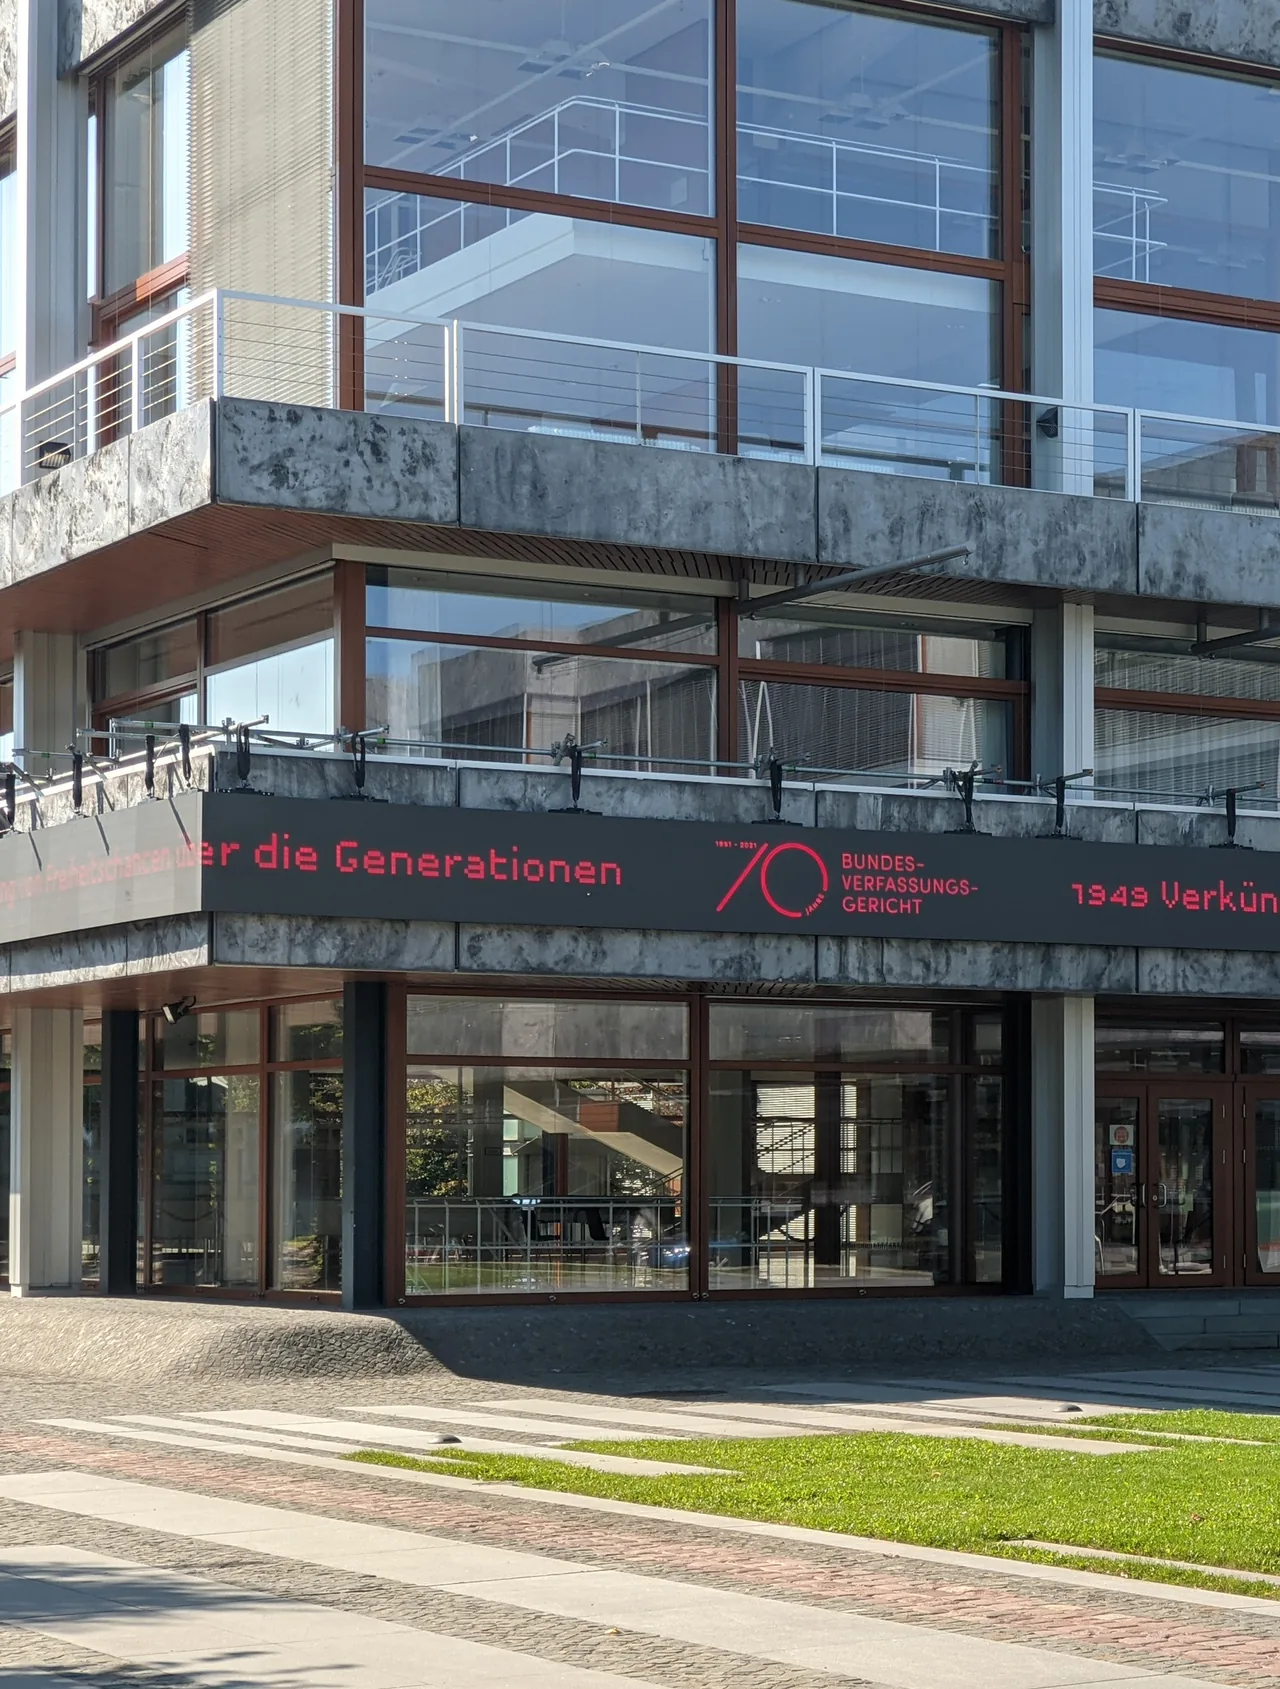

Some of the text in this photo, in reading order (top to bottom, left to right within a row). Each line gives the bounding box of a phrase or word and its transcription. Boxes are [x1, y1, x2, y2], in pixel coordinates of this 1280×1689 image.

[255, 833, 318, 871] die
[336, 841, 622, 885] Generationen
[842, 853, 925, 872] BUNDES-
[842, 874, 979, 896] VERFASSUNGS-
[1072, 883, 1149, 908] 1949
[805, 892, 825, 916] JAHRE
[842, 897, 922, 915] GERICHT
